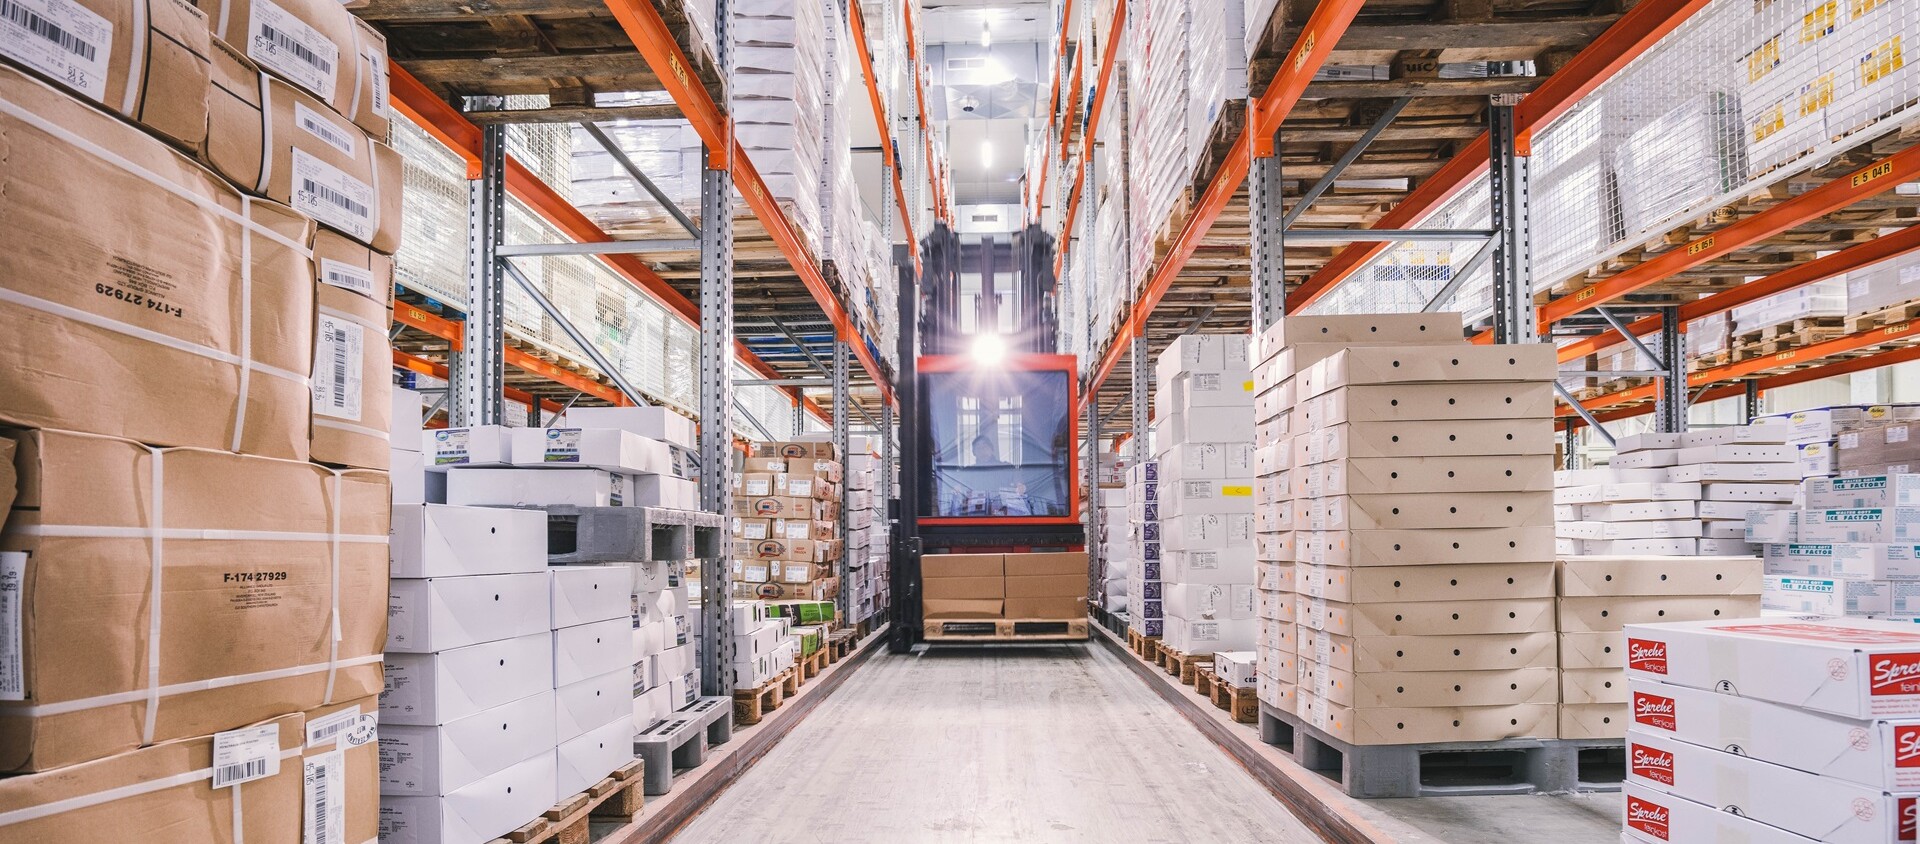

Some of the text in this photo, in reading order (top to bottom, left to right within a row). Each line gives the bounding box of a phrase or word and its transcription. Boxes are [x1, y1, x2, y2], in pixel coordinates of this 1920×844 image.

[95, 282, 182, 318] F-174 27929
[223, 571, 287, 583] F-174 27929
[1631, 643, 1664, 660] Sprehe
[1644, 661, 1666, 673] feinkost
[1873, 659, 1920, 682] Spre
[1636, 697, 1672, 714] Sprehe
[1652, 716, 1675, 729] feinkost
[1634, 749, 1671, 767] Sprehe
[1649, 770, 1673, 783] feinkost
[1629, 802, 1667, 822] Sprehe
[1644, 823, 1667, 837] feinkost
